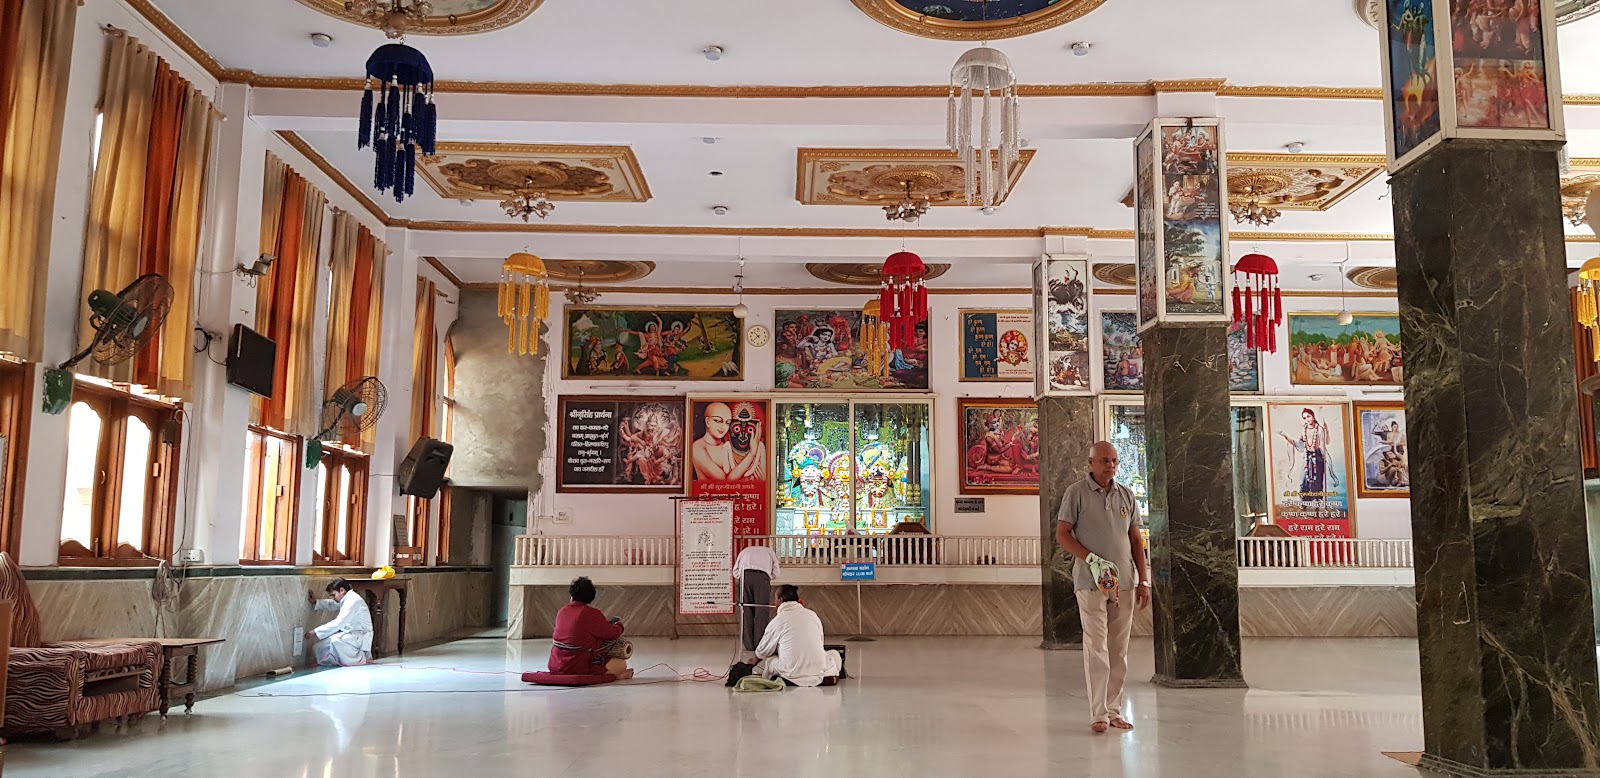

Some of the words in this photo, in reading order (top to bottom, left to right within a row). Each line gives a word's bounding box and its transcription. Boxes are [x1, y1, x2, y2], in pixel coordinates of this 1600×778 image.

[746, 502, 757, 511] हरे
[1282, 499, 1294, 507] हरे
[1294, 500, 1311, 509] कृष्ण
[1312, 499, 1325, 507] हरे
[1326, 500, 1342, 509] कृष्ण
[1288, 523, 1298, 531] हरे
[1315, 523, 1325, 531] हरे
